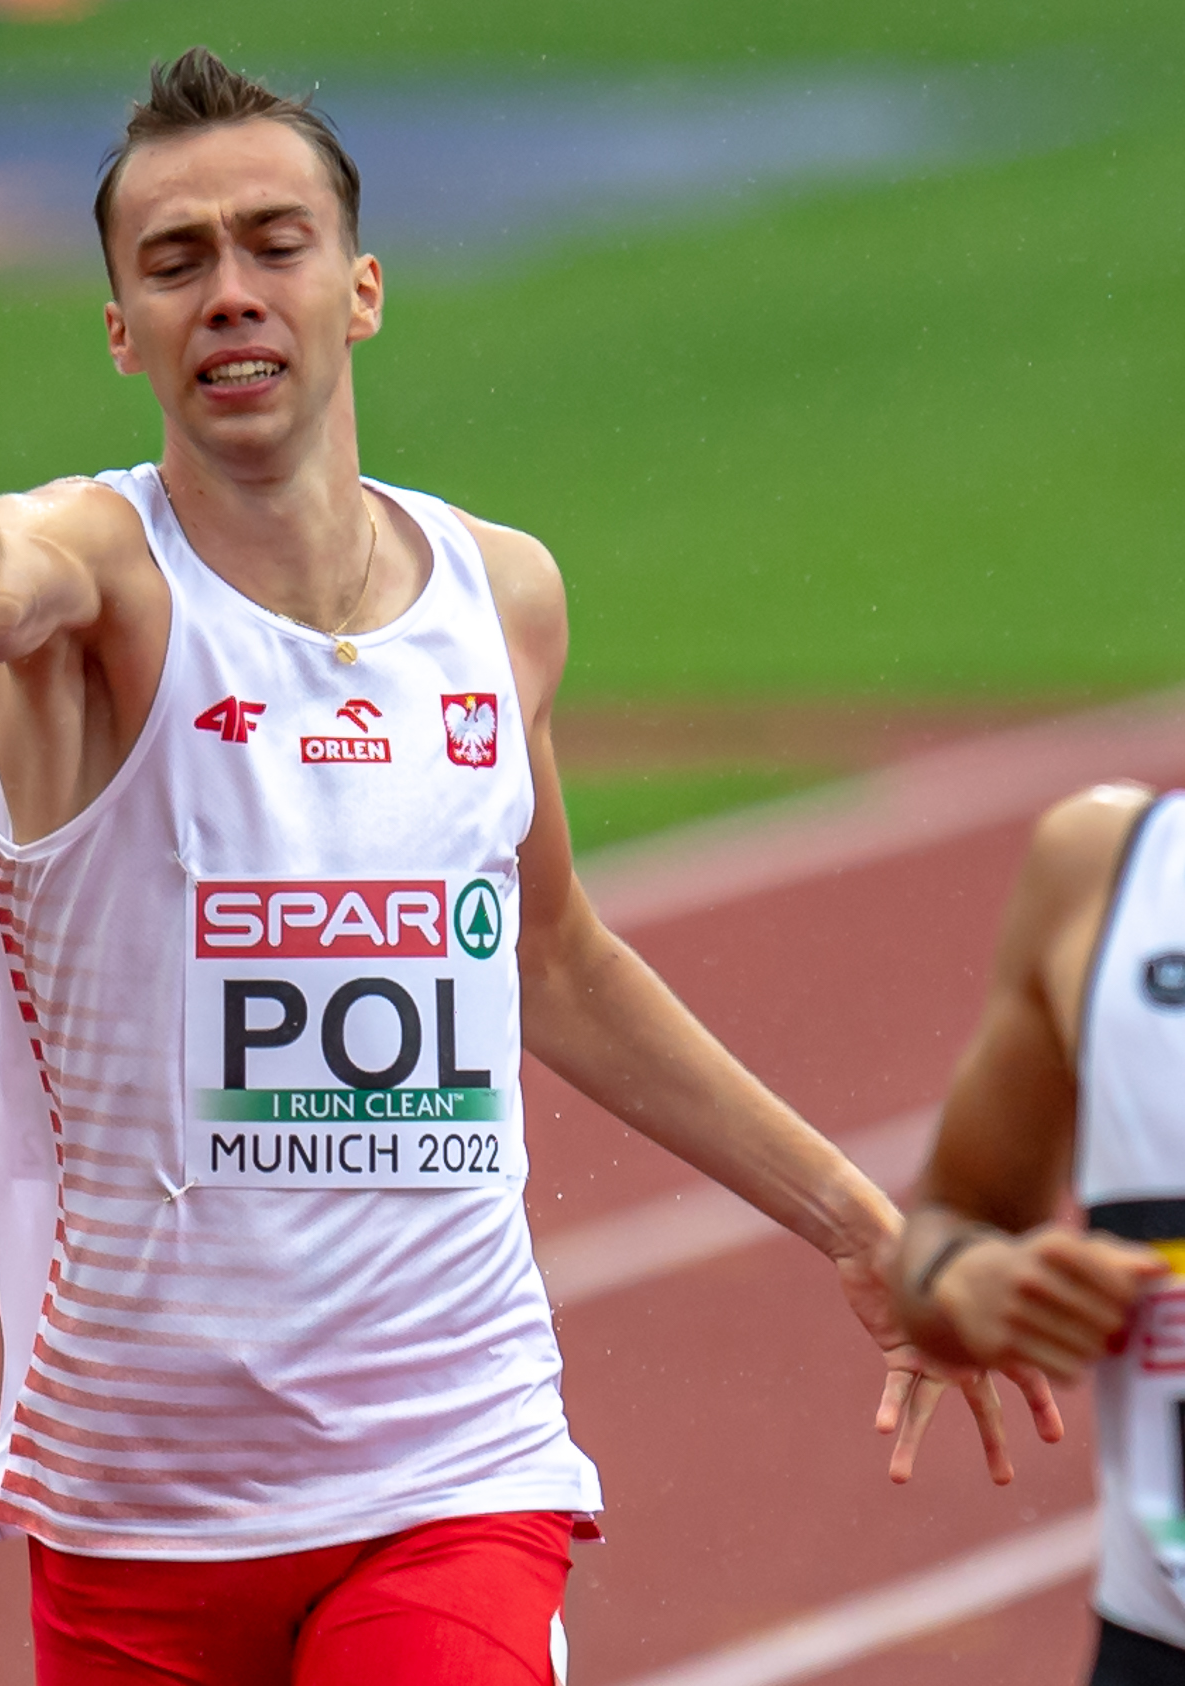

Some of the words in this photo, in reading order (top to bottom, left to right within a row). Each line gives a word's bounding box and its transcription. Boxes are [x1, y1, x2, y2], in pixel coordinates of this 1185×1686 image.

[194, 695, 266, 743] 4F
[305, 738, 386, 760] ORLEN
[204, 891, 441, 948] SPAR
[223, 976, 492, 1090] POL
[272, 1093, 280, 1118] I
[290, 1093, 355, 1118] RUN
[210, 1132, 398, 1173] MUNICH
[418, 1132, 500, 1173] 2022
